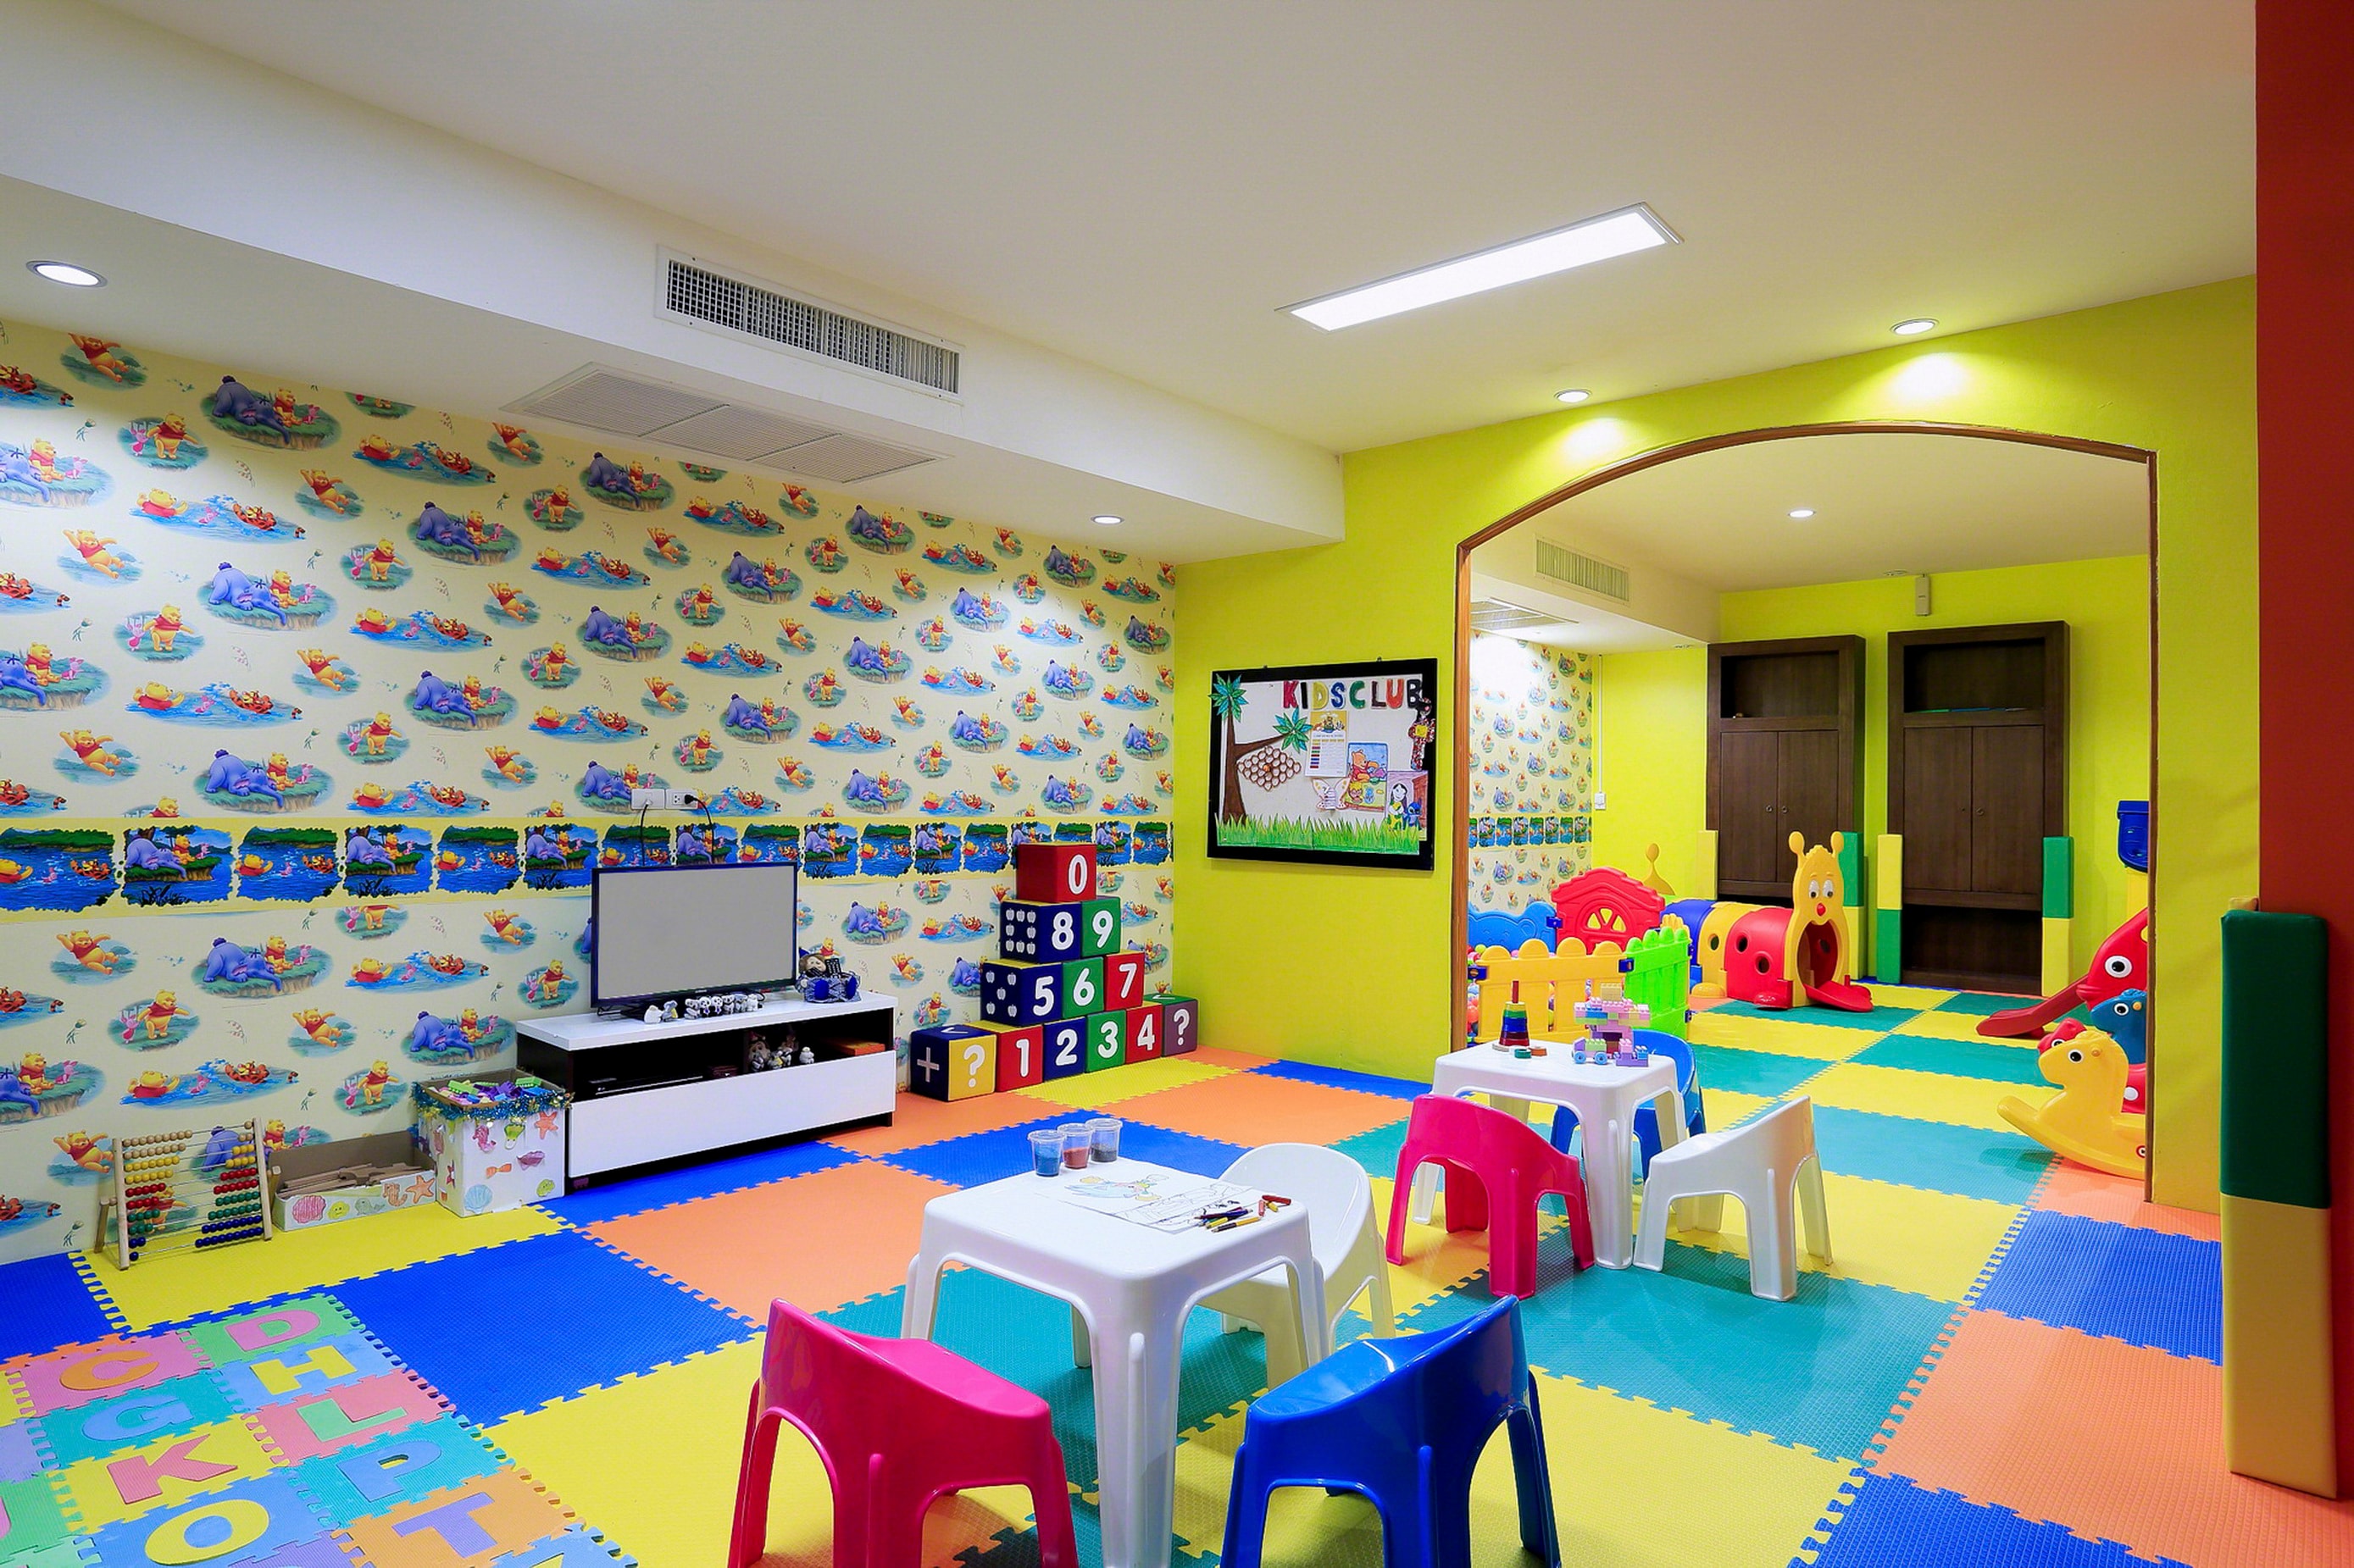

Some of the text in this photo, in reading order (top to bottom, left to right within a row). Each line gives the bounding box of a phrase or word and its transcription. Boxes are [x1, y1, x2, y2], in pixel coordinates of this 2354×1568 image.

[1068, 854, 1088, 895] 0
[1051, 911, 1074, 950] 8
[1092, 910, 1113, 949] 9
[1032, 975, 1055, 1017] 5
[1073, 967, 1095, 1006] 6
[1119, 962, 1137, 999] 7
[1055, 1028, 1078, 1067] 2
[1097, 1021, 1119, 1059] 3
[1137, 1013, 1155, 1051] 4
[1173, 1008, 1190, 1046] ?
[963, 1044, 985, 1088] ?
[1015, 1039, 1030, 1078] 1
[225, 1310, 320, 1352] D
[59, 1349, 159, 1391] C
[249, 1345, 358, 1395] H
[82, 1395, 195, 1441] G
[297, 1398, 408, 1441] L
[107, 1434, 238, 1504] K
[338, 1440, 442, 1503] P
[145, 1499, 269, 1565] O
[391, 1492, 498, 1560] T
